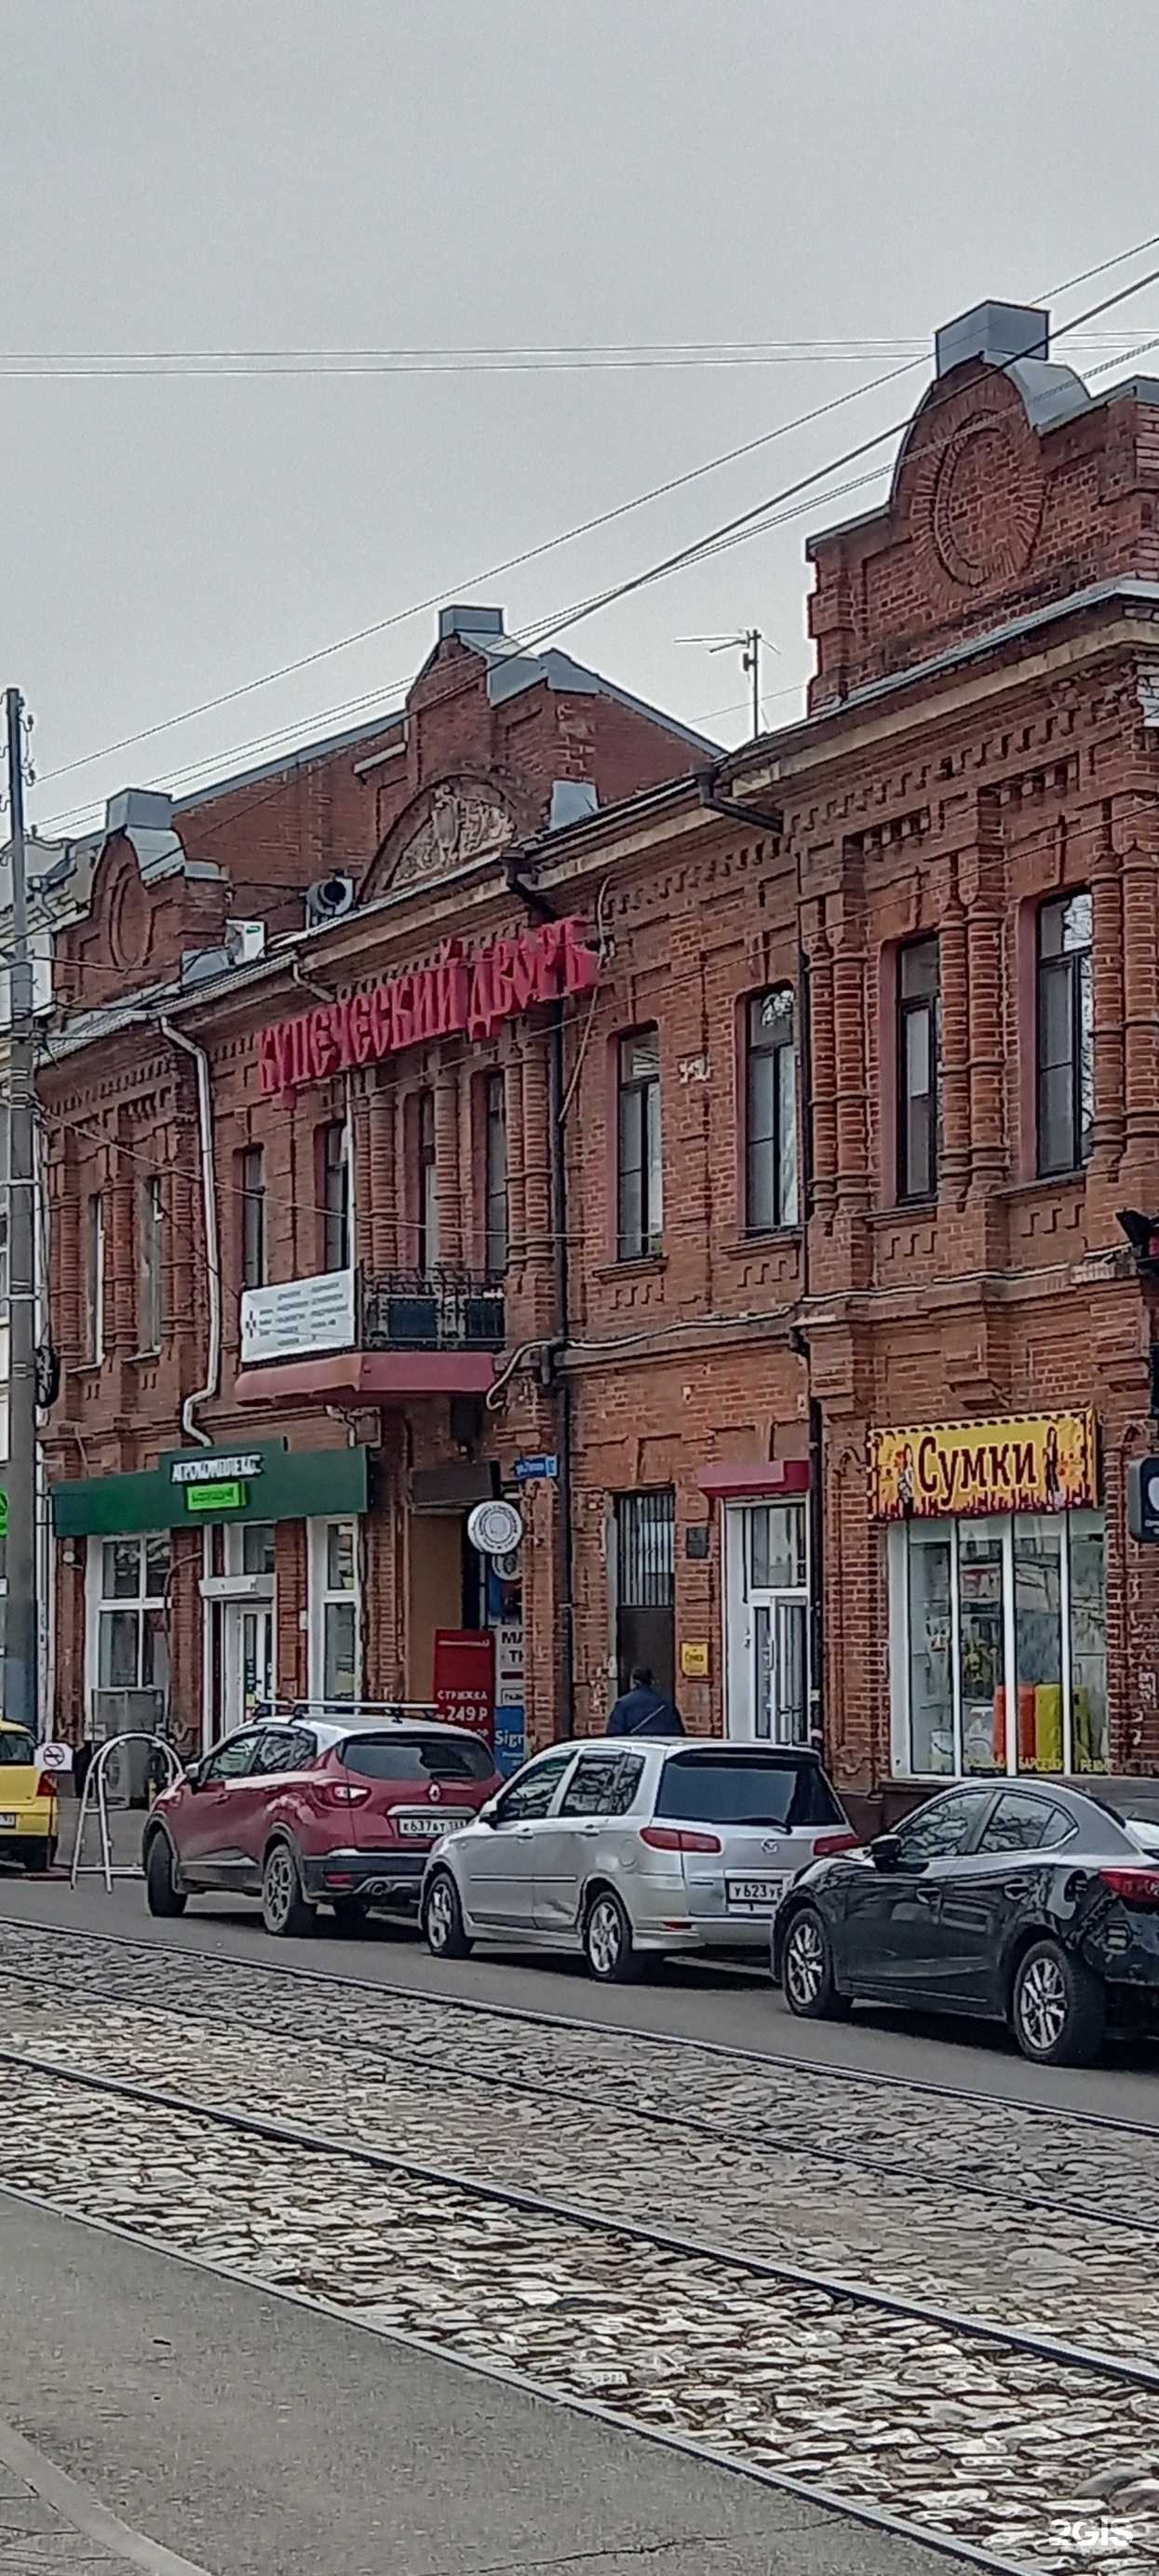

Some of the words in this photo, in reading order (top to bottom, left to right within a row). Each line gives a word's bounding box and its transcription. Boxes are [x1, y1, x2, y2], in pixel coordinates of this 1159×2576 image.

[919, 1436, 1036, 1506] Сумки
[437, 1689, 489, 1701] СТРИЖКА
[446, 1706, 477, 1722] 249
